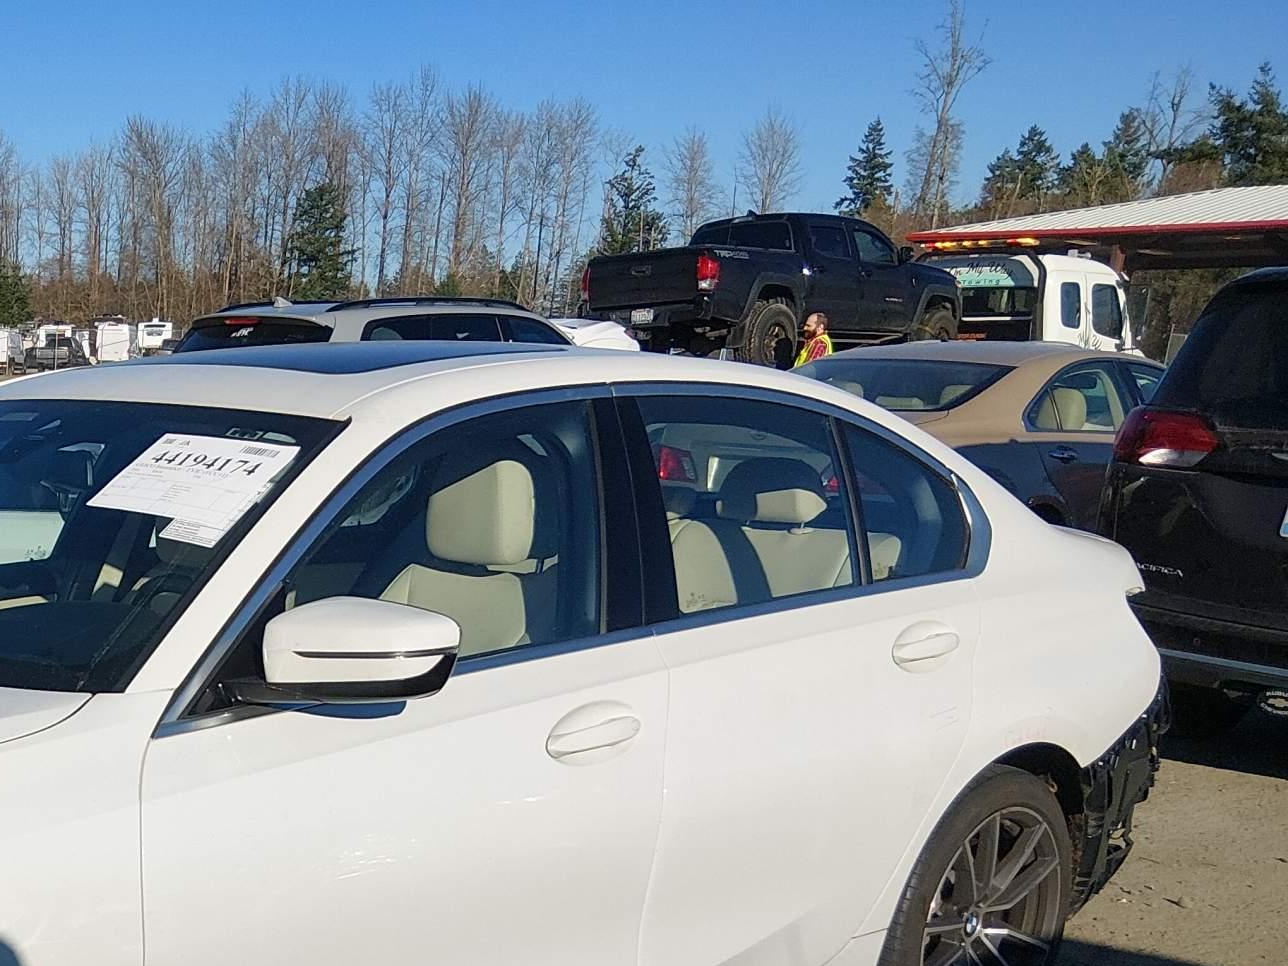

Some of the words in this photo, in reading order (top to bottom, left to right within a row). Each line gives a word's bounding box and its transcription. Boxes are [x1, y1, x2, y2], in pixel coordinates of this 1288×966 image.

[965, 261, 985, 278] My
[152, 450, 263, 476] 44194174
[1136, 562, 1184, 578] ACIFICA
